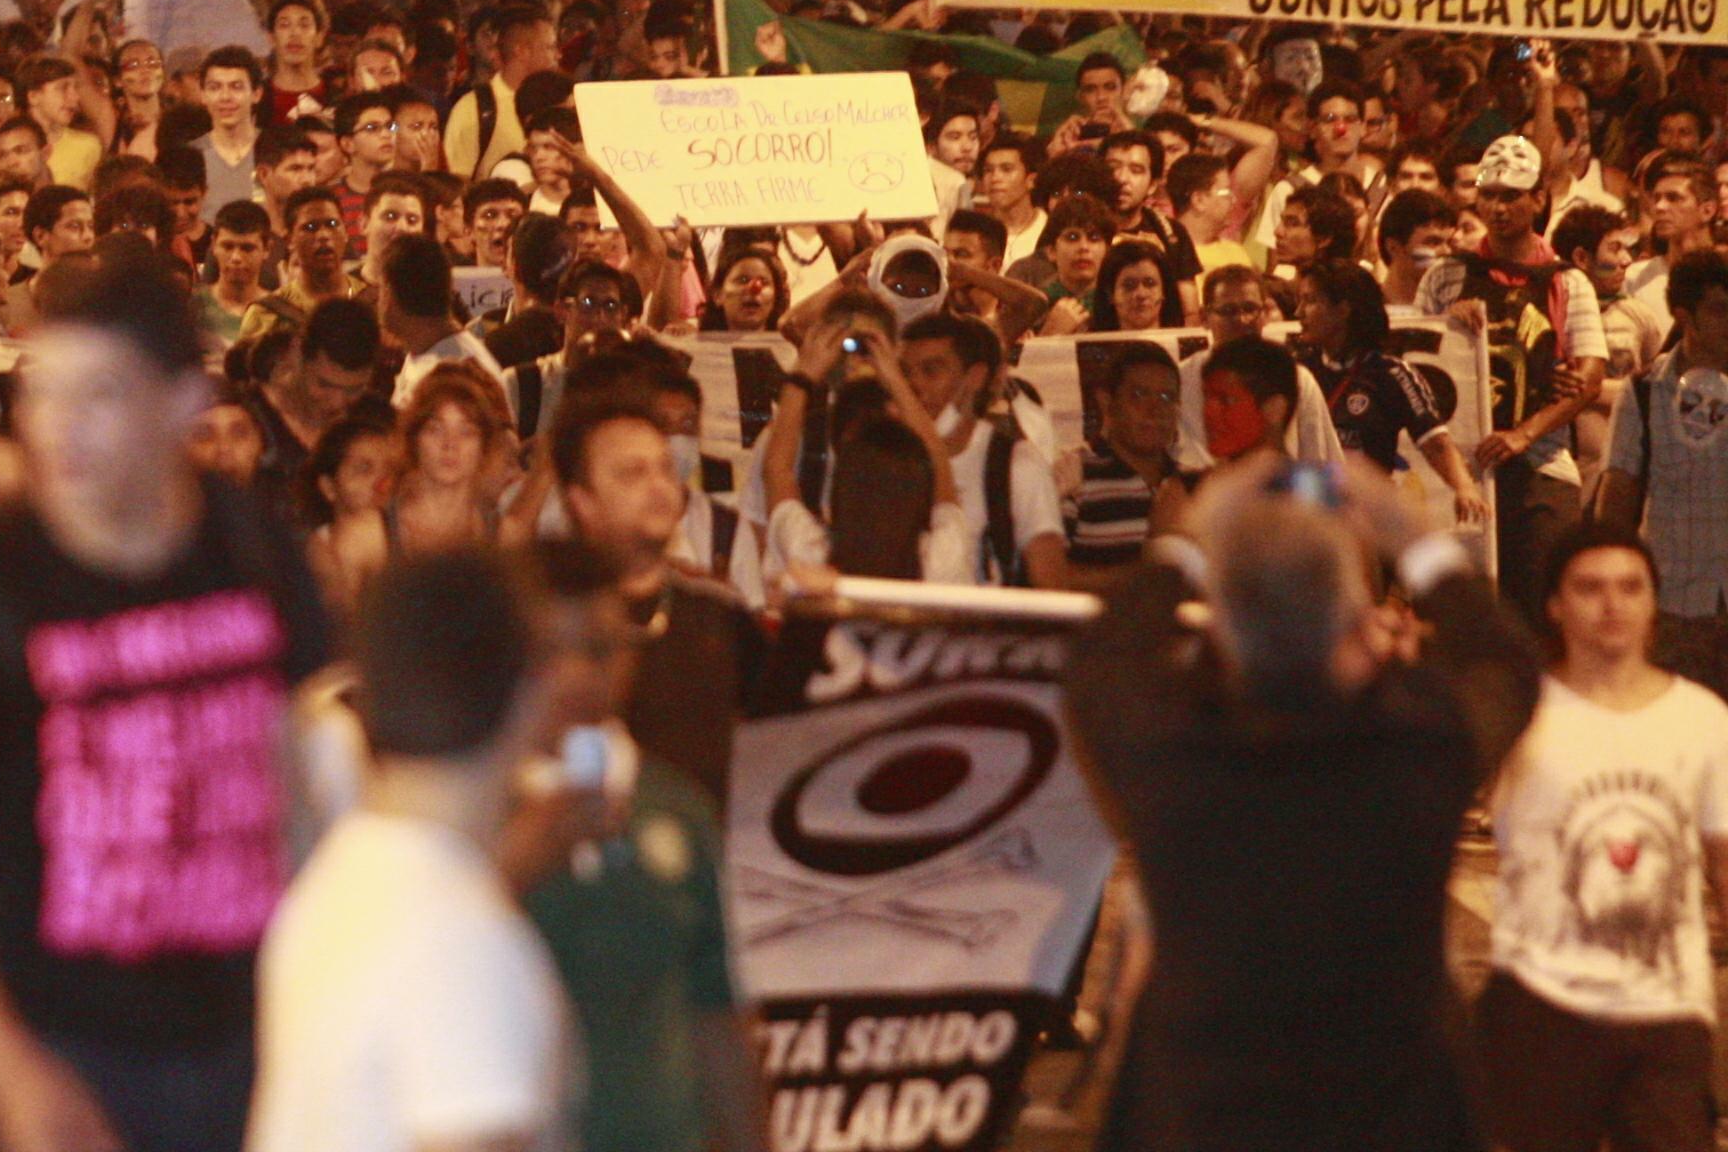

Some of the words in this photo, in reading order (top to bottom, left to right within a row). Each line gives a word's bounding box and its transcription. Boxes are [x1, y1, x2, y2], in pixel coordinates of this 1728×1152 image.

[660, 108, 747, 134] ESCOLA
[601, 145, 664, 175] PEDE
[687, 128, 833, 170] SOCORRO!
[675, 179, 749, 210] TERRA
[756, 175, 825, 205] FIRME
[762, 1002, 828, 1074] TÁ
[836, 1009, 1018, 1074] SENDO
[771, 1072, 991, 1152] ULADO
